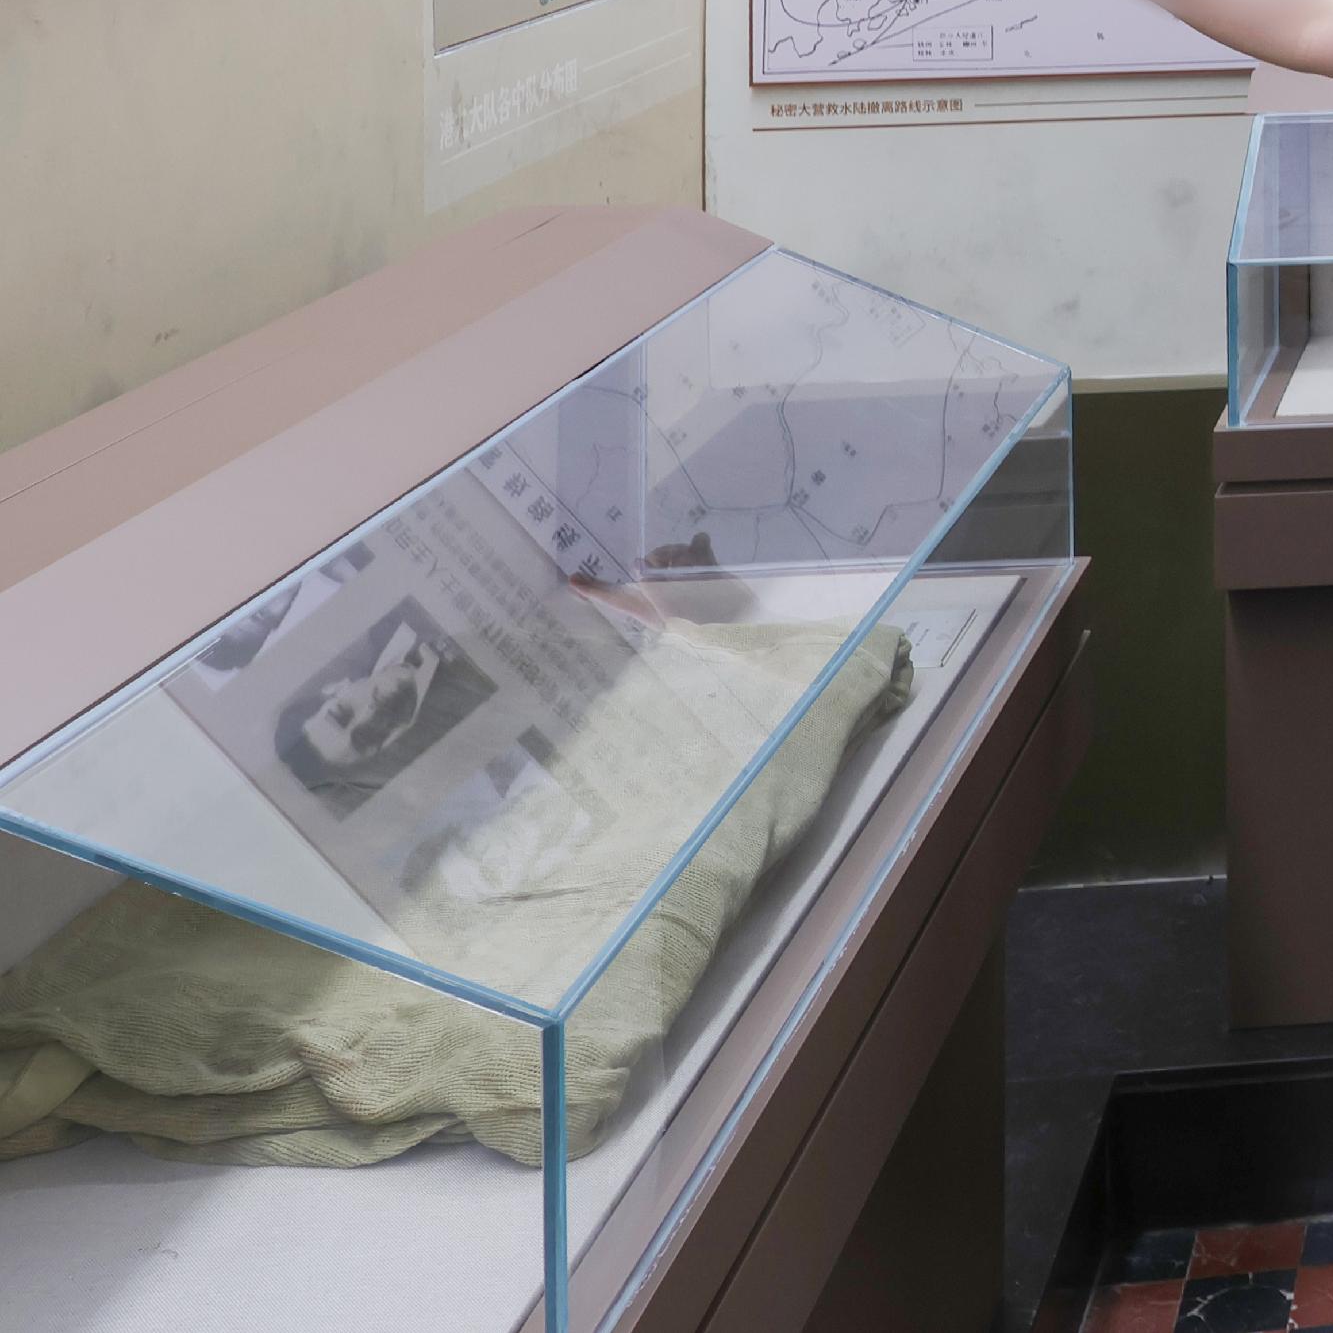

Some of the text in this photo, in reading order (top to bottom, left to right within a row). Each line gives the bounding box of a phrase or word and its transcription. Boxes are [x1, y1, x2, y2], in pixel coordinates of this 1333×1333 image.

[770, 98, 964, 118] 秘密大营救水陆撤离路线示意图
